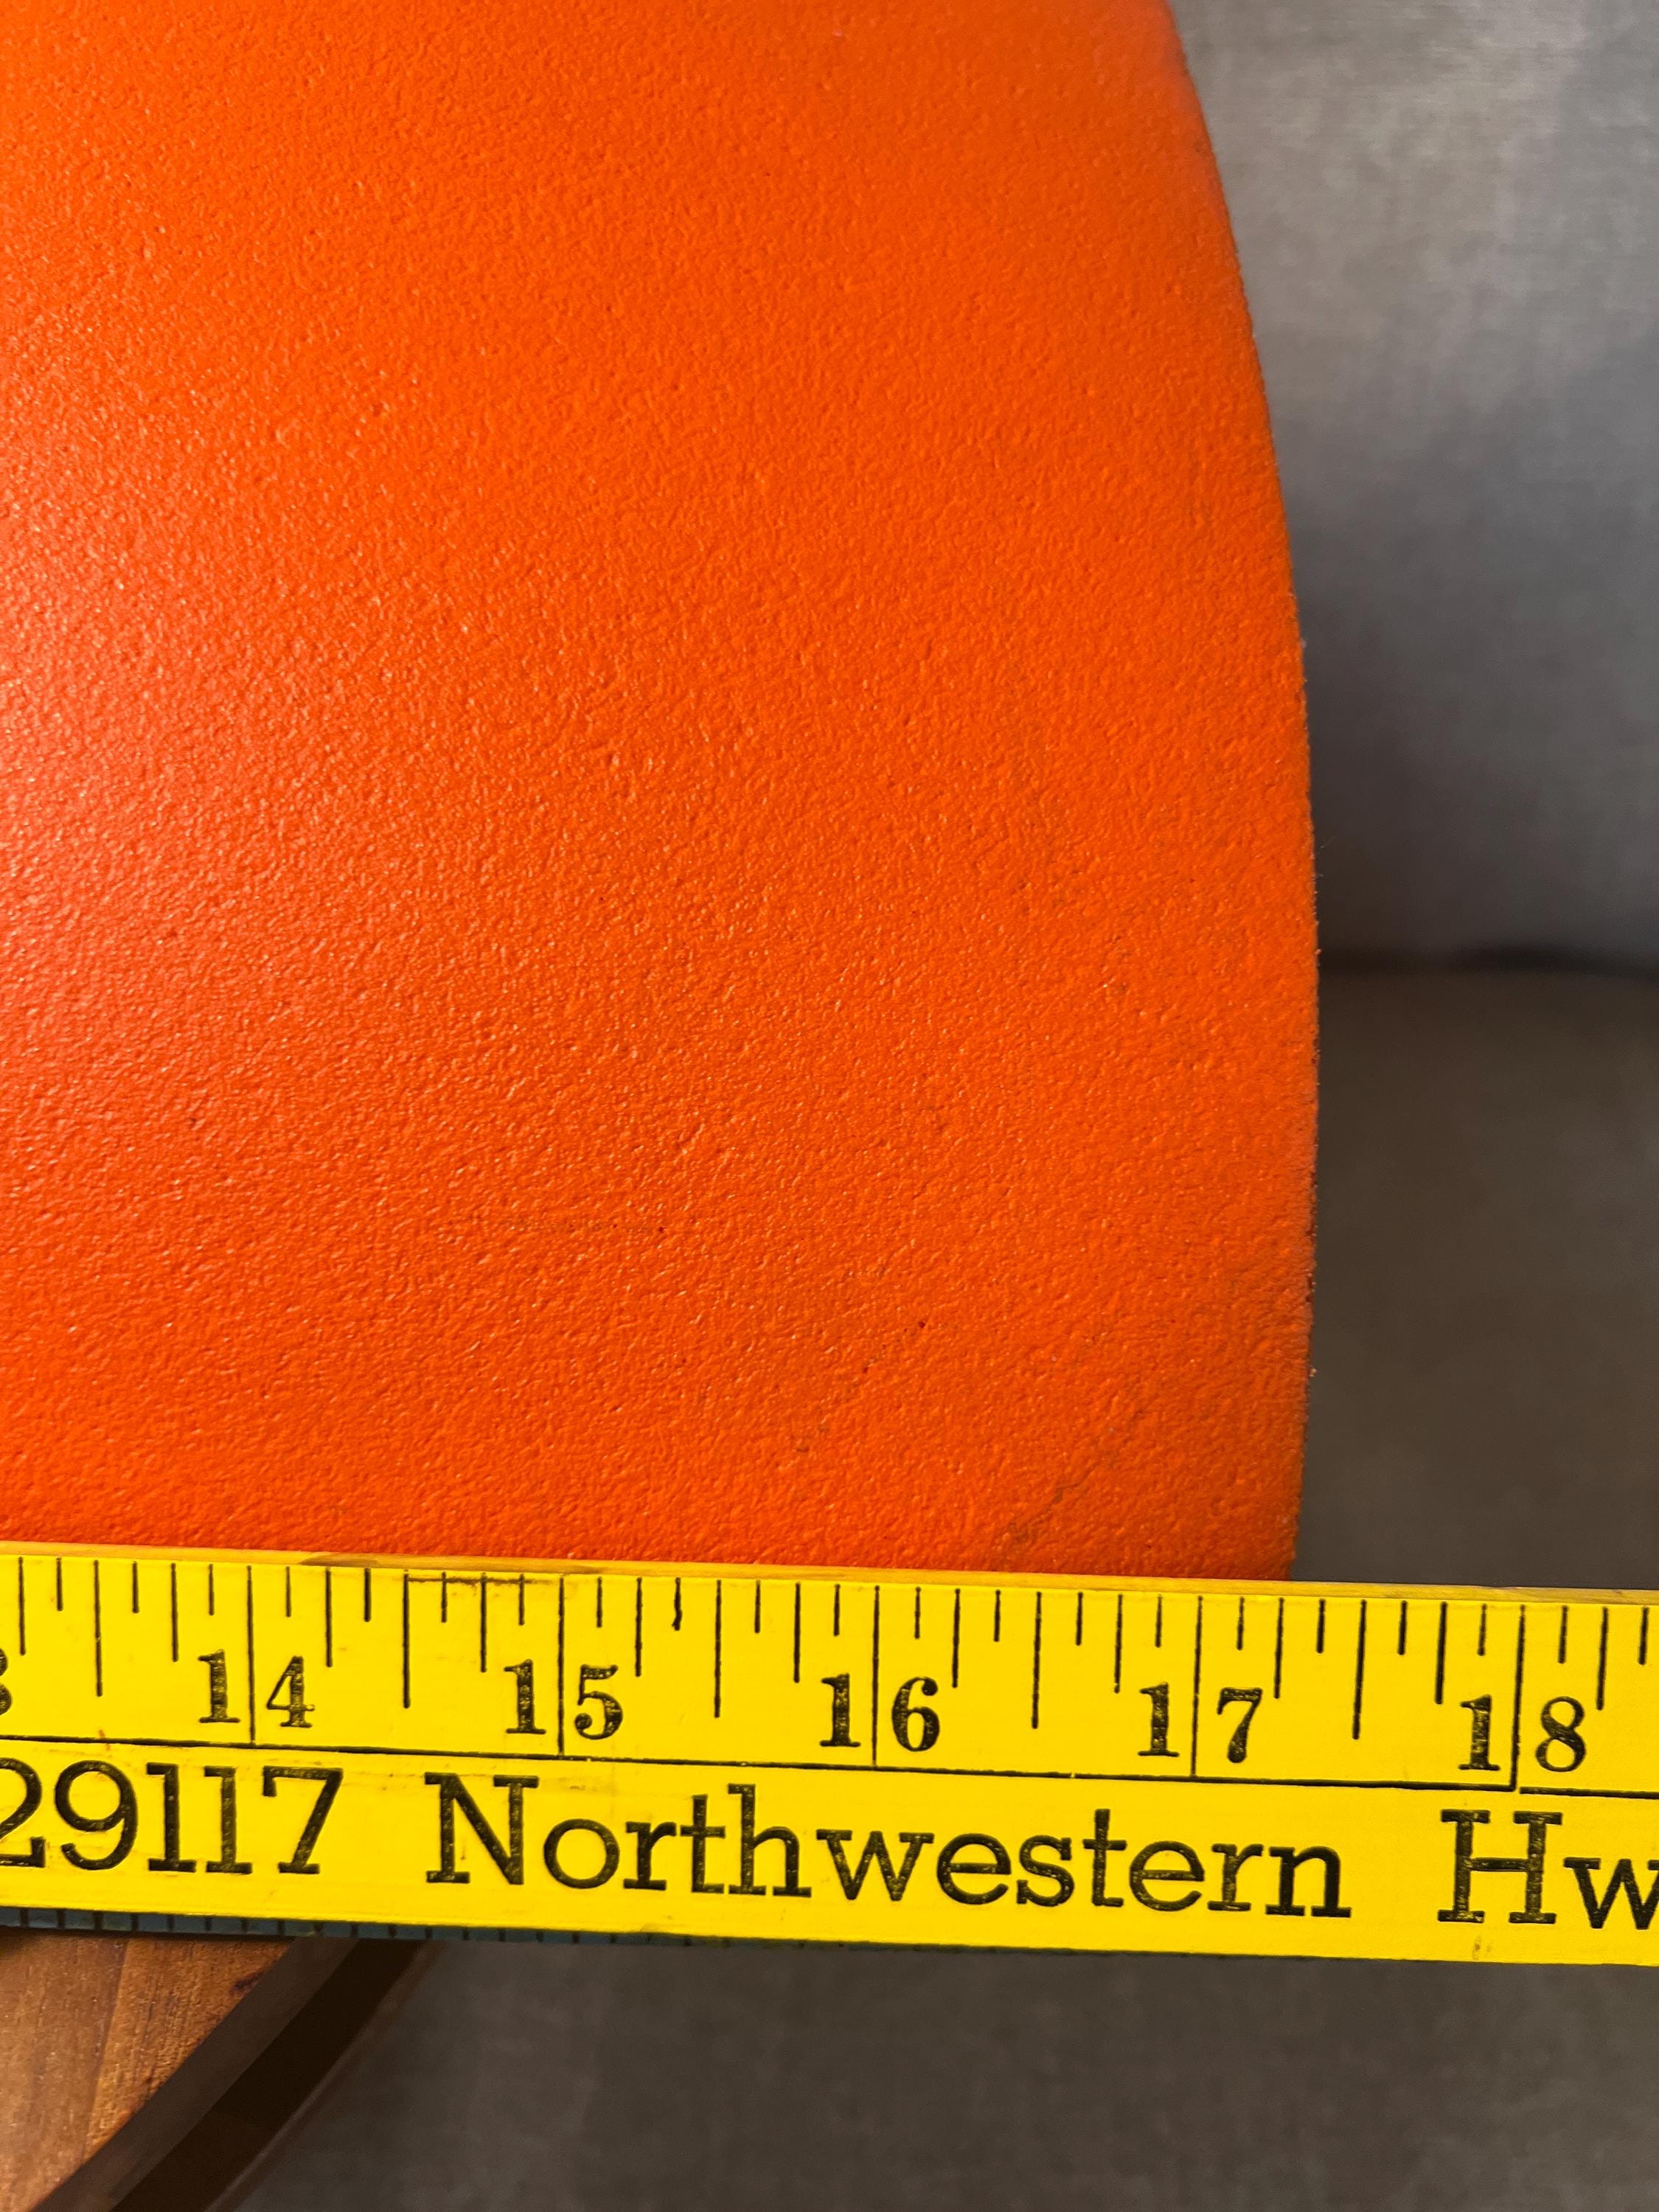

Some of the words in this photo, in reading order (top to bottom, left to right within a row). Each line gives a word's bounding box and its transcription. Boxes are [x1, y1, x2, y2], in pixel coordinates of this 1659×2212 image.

[198, 1649, 316, 1728] 14
[504, 1658, 624, 1740] 15
[819, 1672, 940, 1752] 16
[1138, 1682, 1263, 1764] 17
[1458, 1694, 1587, 1773] 18
[0, 1757, 344, 1875] 29117
[424, 1771, 1352, 1919] Northwestern
[1438, 1808, 1659, 1930] Hw
